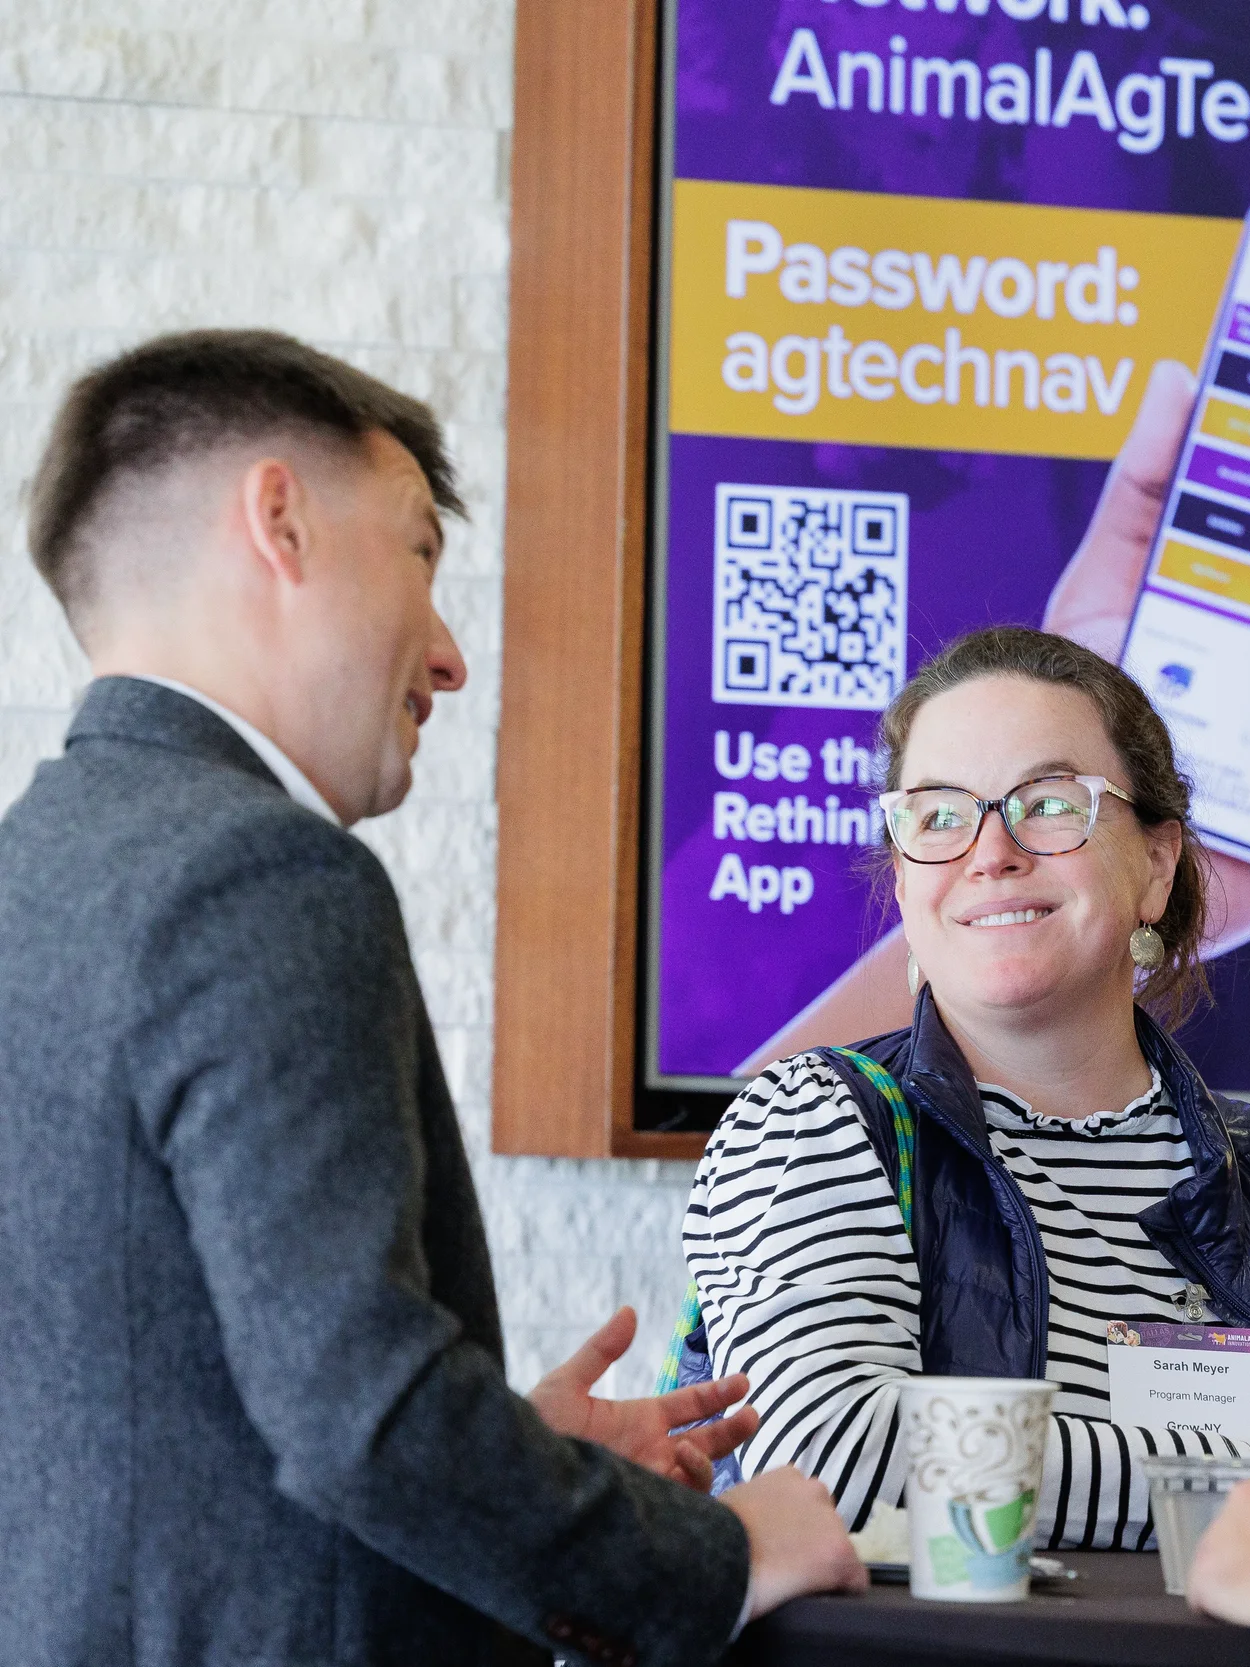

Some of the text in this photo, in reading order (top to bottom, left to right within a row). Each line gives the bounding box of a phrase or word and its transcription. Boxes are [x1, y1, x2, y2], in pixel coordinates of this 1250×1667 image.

[724, 220, 1140, 325] Password:
[721, 328, 1136, 416] agtechnav
[714, 730, 811, 782] Use
[709, 853, 814, 914] App
[1153, 1359, 1230, 1375] Sarah Meyer
[1149, 1389, 1236, 1404] Program Manager
[1166, 1421, 1222, 1434] Grow-NY
